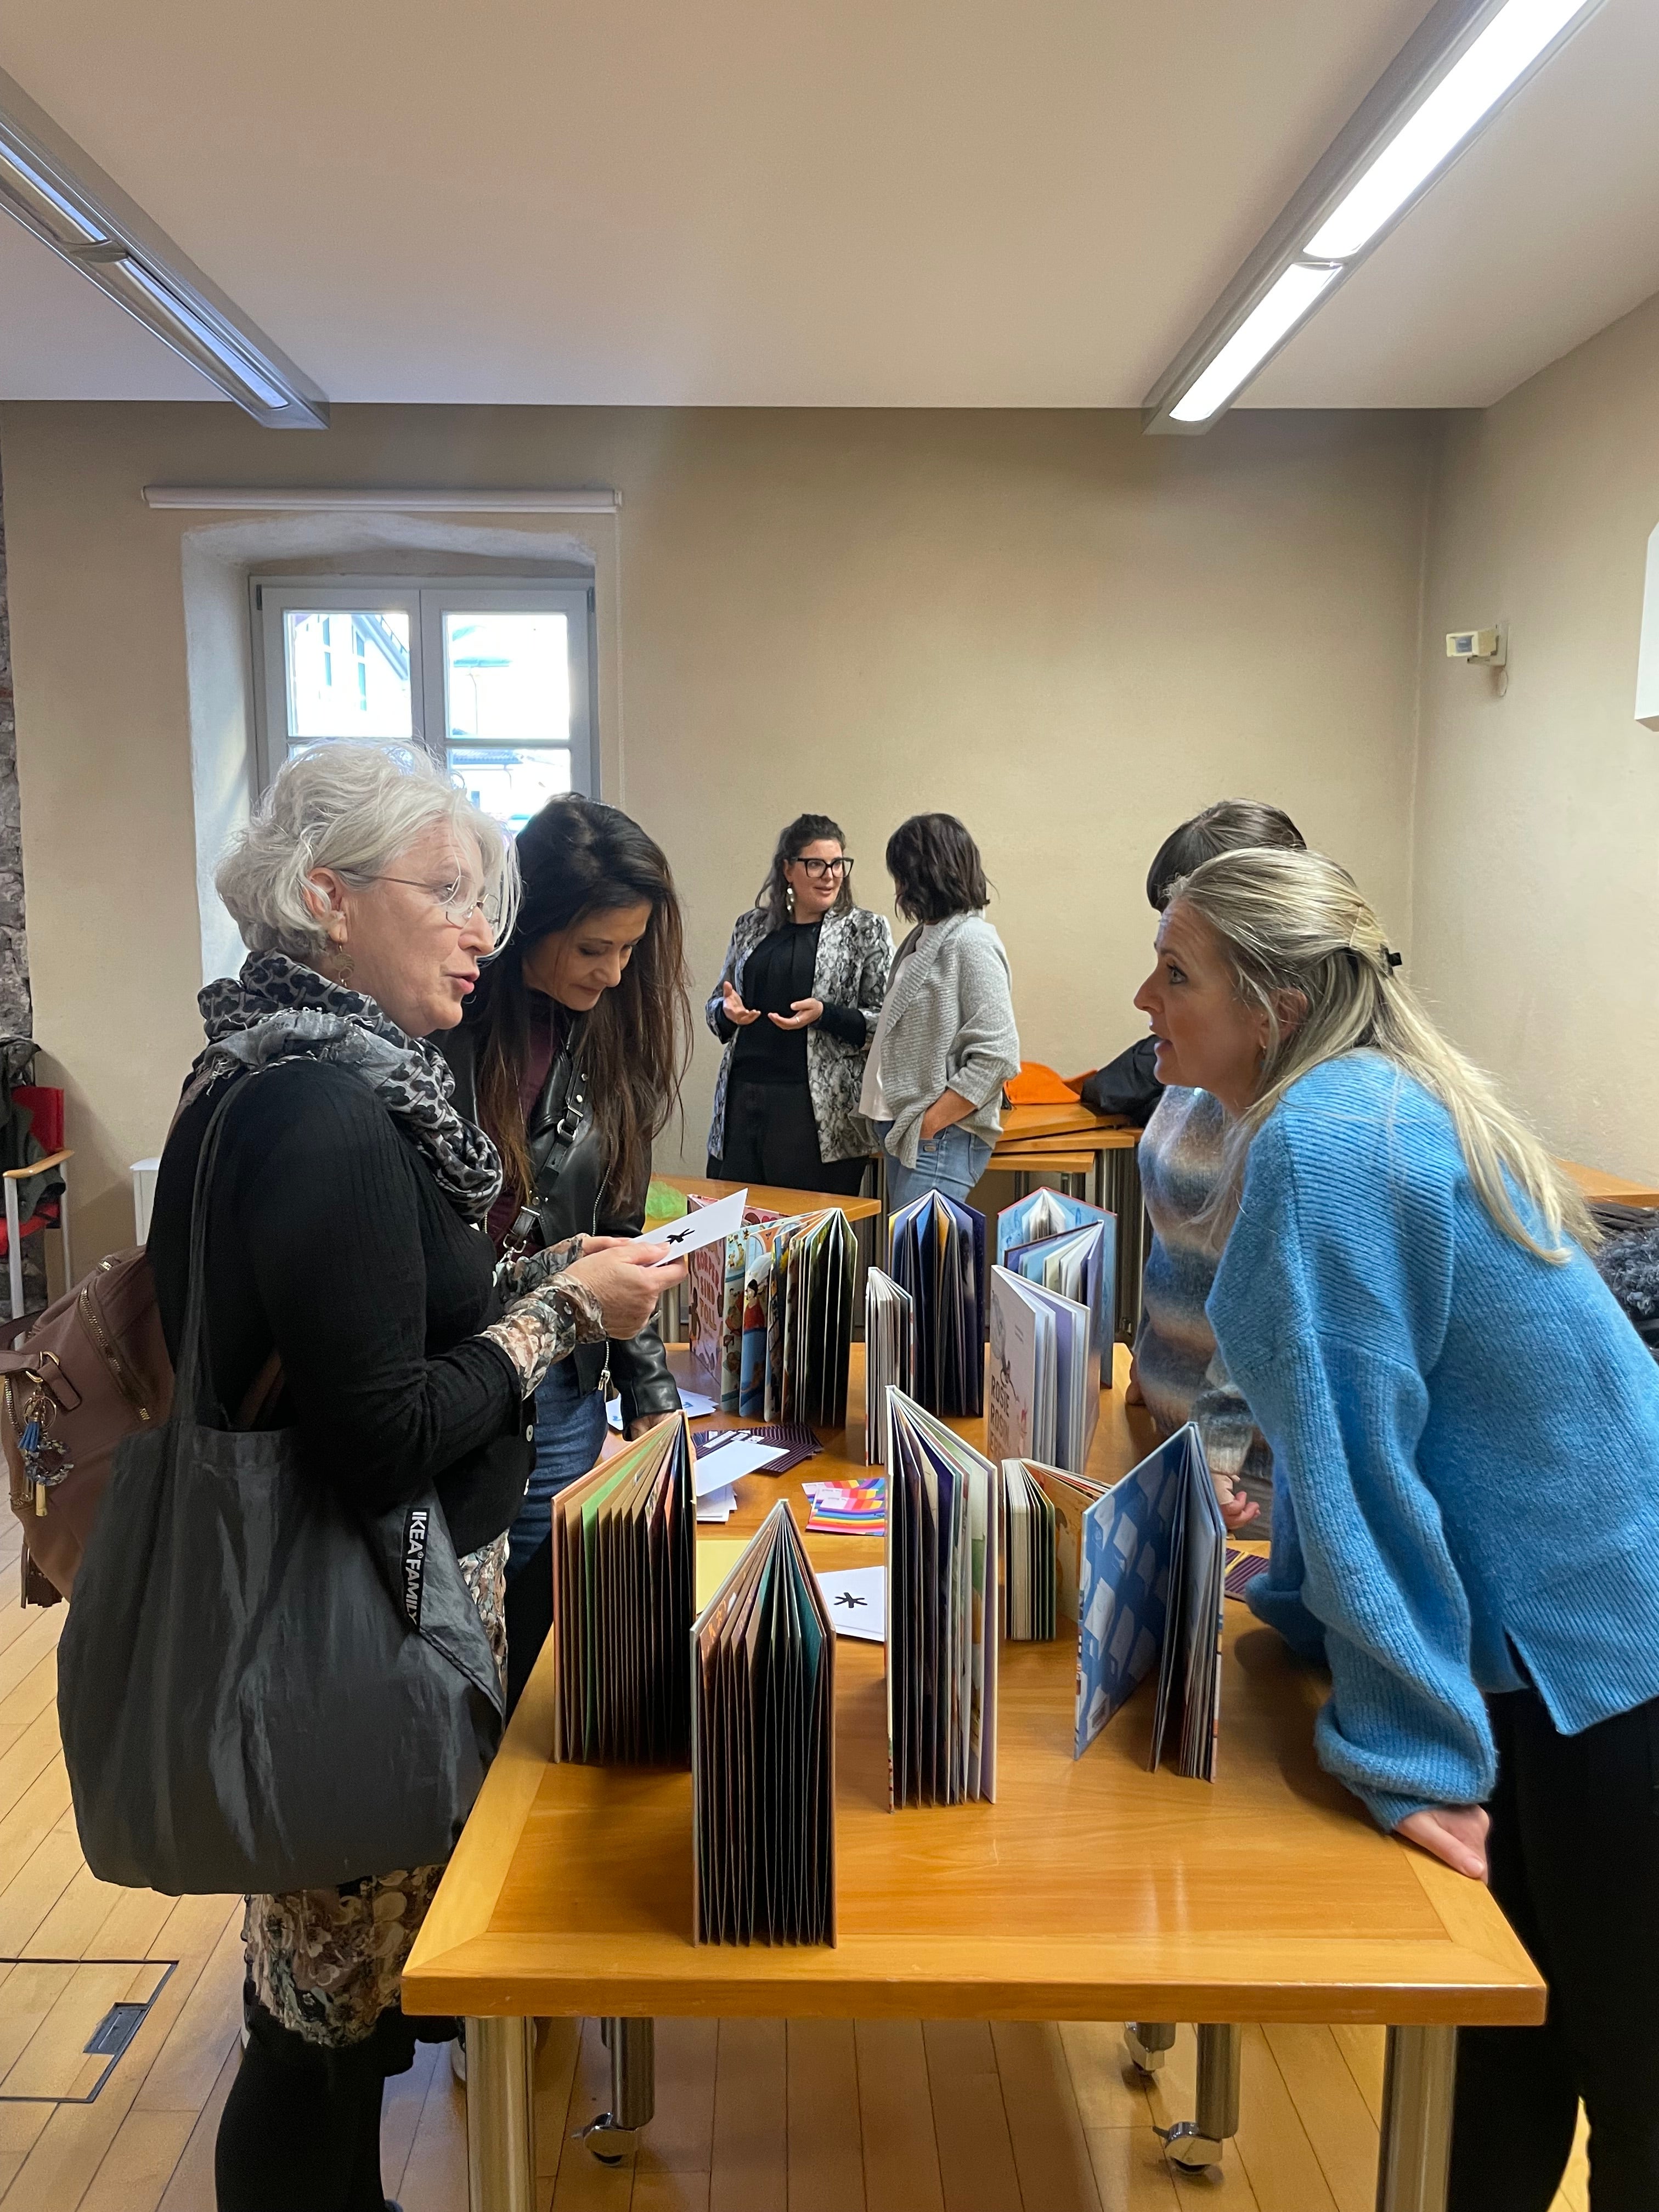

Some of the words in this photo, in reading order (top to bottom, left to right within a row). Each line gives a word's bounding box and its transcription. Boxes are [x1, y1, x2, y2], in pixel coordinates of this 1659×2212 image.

[701, 1276, 715, 1305] SIND
[699, 1297, 716, 1331] TOLL
[991, 1375, 1009, 1418] ROSIE
[405, 1559, 420, 1626] FAMILY
